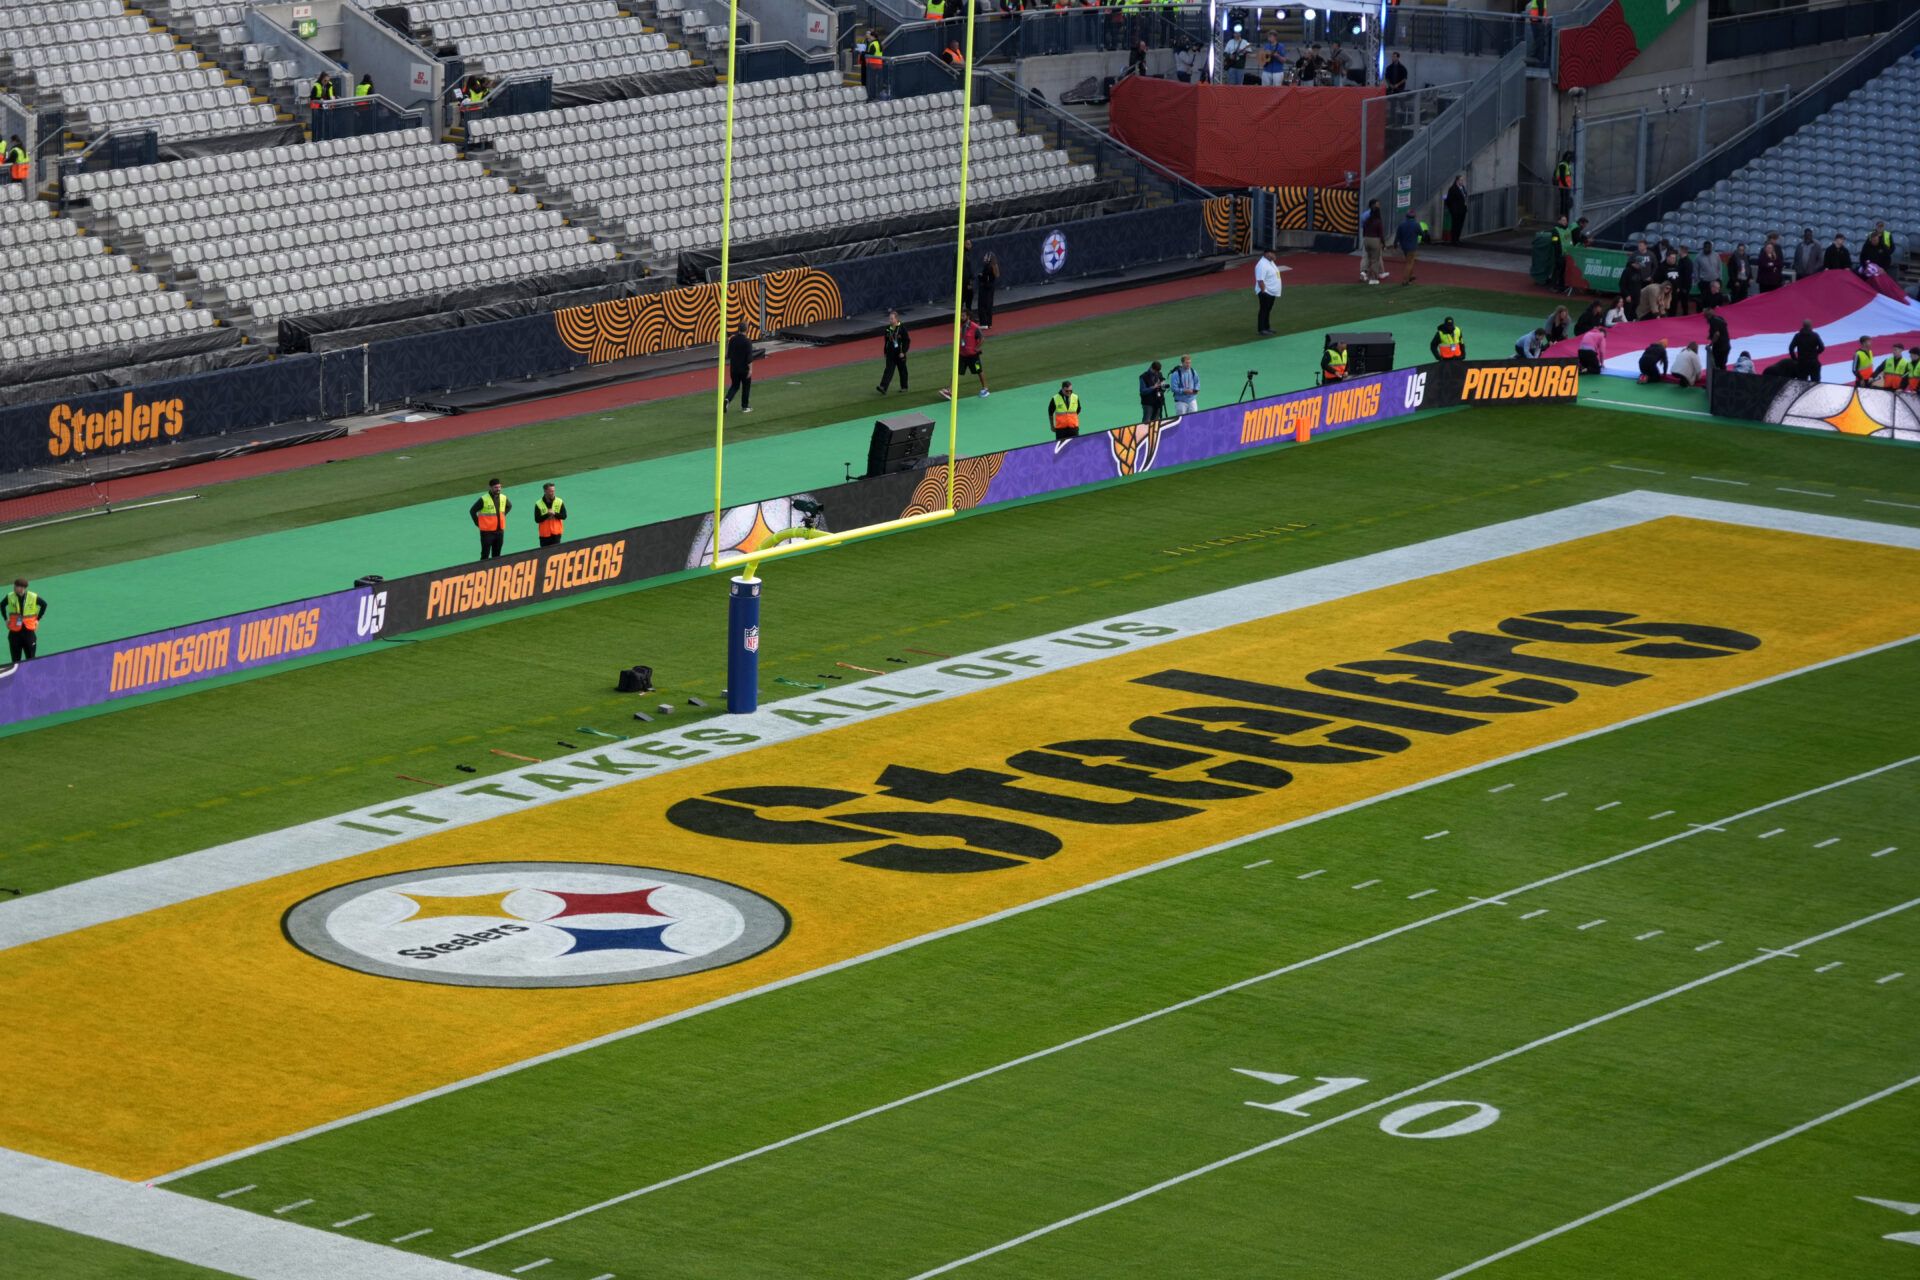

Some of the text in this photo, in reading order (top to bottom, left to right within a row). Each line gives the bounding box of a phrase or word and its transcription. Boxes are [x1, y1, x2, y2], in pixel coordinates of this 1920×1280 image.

[48, 391, 184, 457] Steelers
[1325, 382, 1382, 426] VIKINGS
[109, 627, 230, 693] MINNESOTA
[237, 607, 320, 664] VIKINGS
[426, 558, 538, 620] PITTSBURGH
[542, 539, 626, 594] STEELERS
[337, 622, 1179, 836] IT TAKES ALL OF US
[665, 609, 1762, 873] Steelers
[397, 924, 530, 959] Steelers
